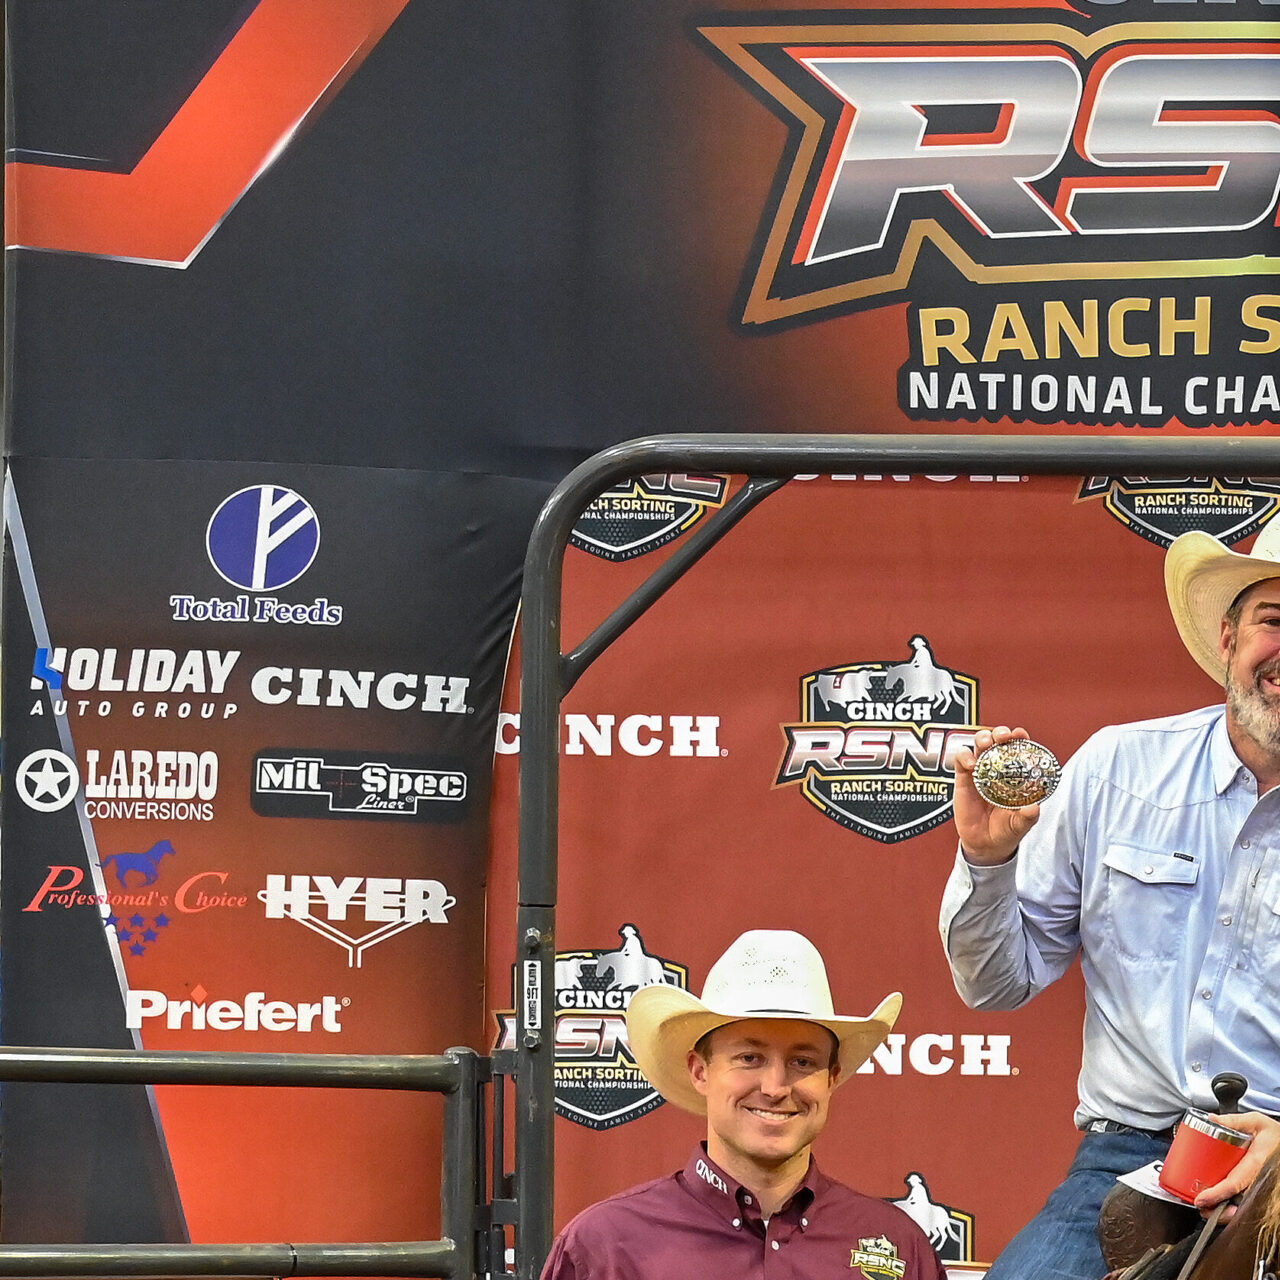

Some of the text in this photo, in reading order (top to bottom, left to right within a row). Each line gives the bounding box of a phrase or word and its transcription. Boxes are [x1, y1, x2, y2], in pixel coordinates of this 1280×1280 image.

[918, 296, 1212, 366] RANCH
[907, 369, 1164, 416] NATIONAL
[612, 499, 676, 513] SORTING
[1134, 494, 1253, 508] RANCH SORTING
[1135, 507, 1253, 515] NATIONAL CHAMPIONSHIPS
[604, 512, 676, 520] CHAMPIONSHIPS
[170, 595, 342, 626] Total Feeds
[31, 647, 242, 692] HOLIDAY
[250, 666, 470, 714] CINCH
[30, 701, 239, 719] AUTO GROUP
[847, 702, 932, 721] CINCH
[495, 713, 720, 757] CNCH
[85, 749, 218, 801] LAREDO
[260, 760, 463, 799] Mil Spec
[830, 781, 948, 795] RANCH SORTING
[83, 801, 214, 821] CONVERSIONS
[356, 795, 405, 811] Liner
[831, 793, 948, 802] NATIONAL CHAMPIONSHIPS
[22, 865, 248, 913] Professional's Choice
[265, 874, 449, 924] HYER
[126, 985, 342, 1032] Priefert
[855, 1033, 1011, 1076] NCH
[553, 1068, 592, 1079] ANCH
[554, 1080, 586, 1088] TIONAL
[696, 1159, 728, 1195] CINCH
[853, 1252, 906, 1276] RSNC
